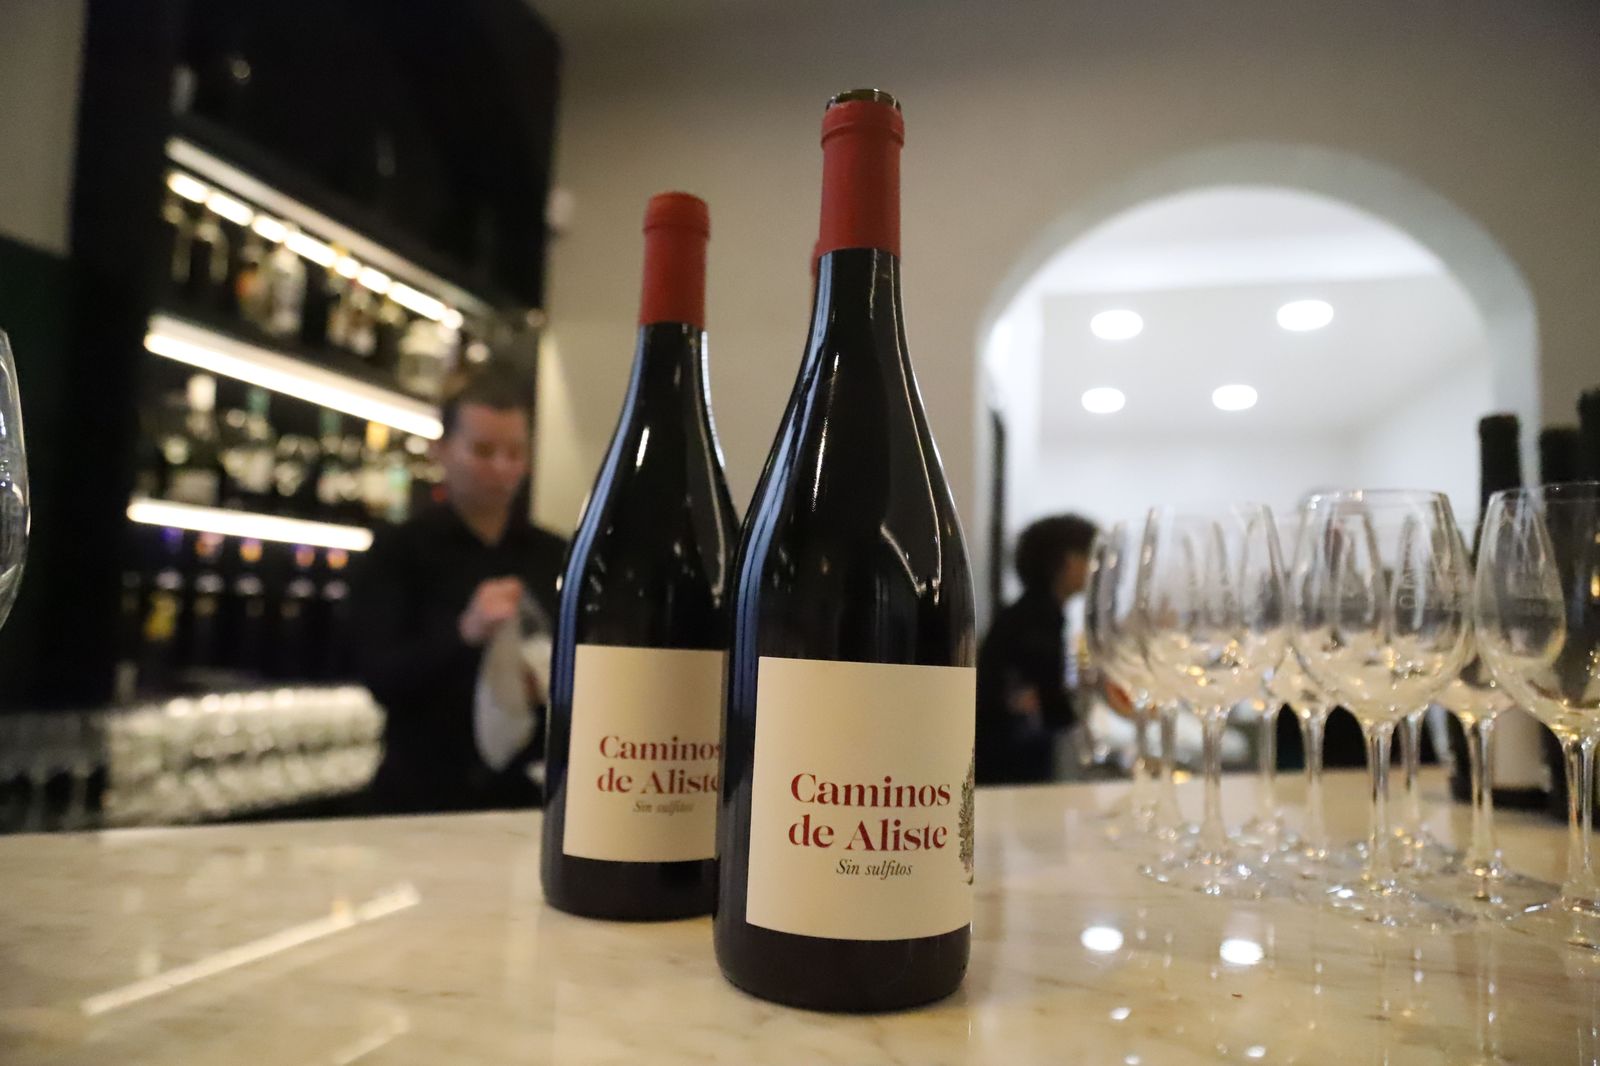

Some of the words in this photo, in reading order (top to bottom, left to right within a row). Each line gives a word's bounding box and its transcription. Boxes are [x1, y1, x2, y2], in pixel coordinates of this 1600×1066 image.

[597, 767, 633, 793] de
[791, 773, 951, 807] Caminos
[788, 814, 835, 848] de
[844, 818, 948, 851] Aliste
[836, 859, 860, 875] Sin
[865, 860, 913, 880] sulfitos
